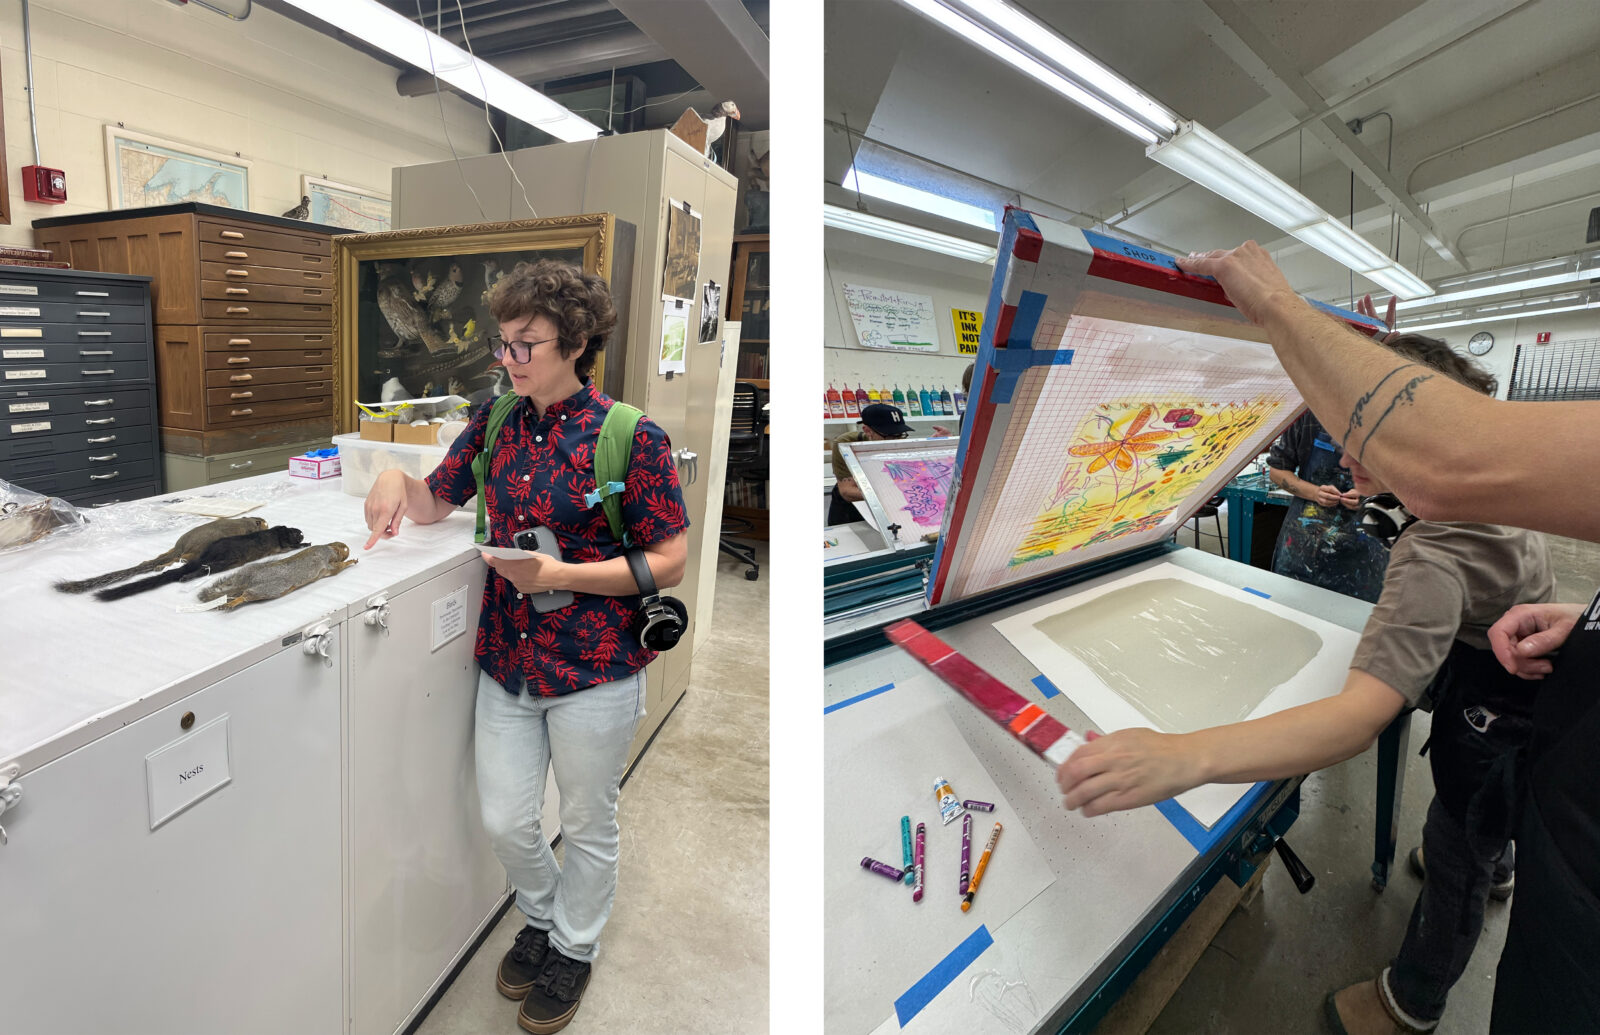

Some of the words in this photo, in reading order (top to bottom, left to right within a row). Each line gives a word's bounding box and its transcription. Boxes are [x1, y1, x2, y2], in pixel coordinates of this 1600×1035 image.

[1123, 246, 1157, 262] SHOP
[958, 310, 977, 322] IT'S
[960, 321, 978, 333] INK
[961, 333, 980, 343] NOT
[891, 411, 901, 423] H
[178, 764, 204, 784] Nests
